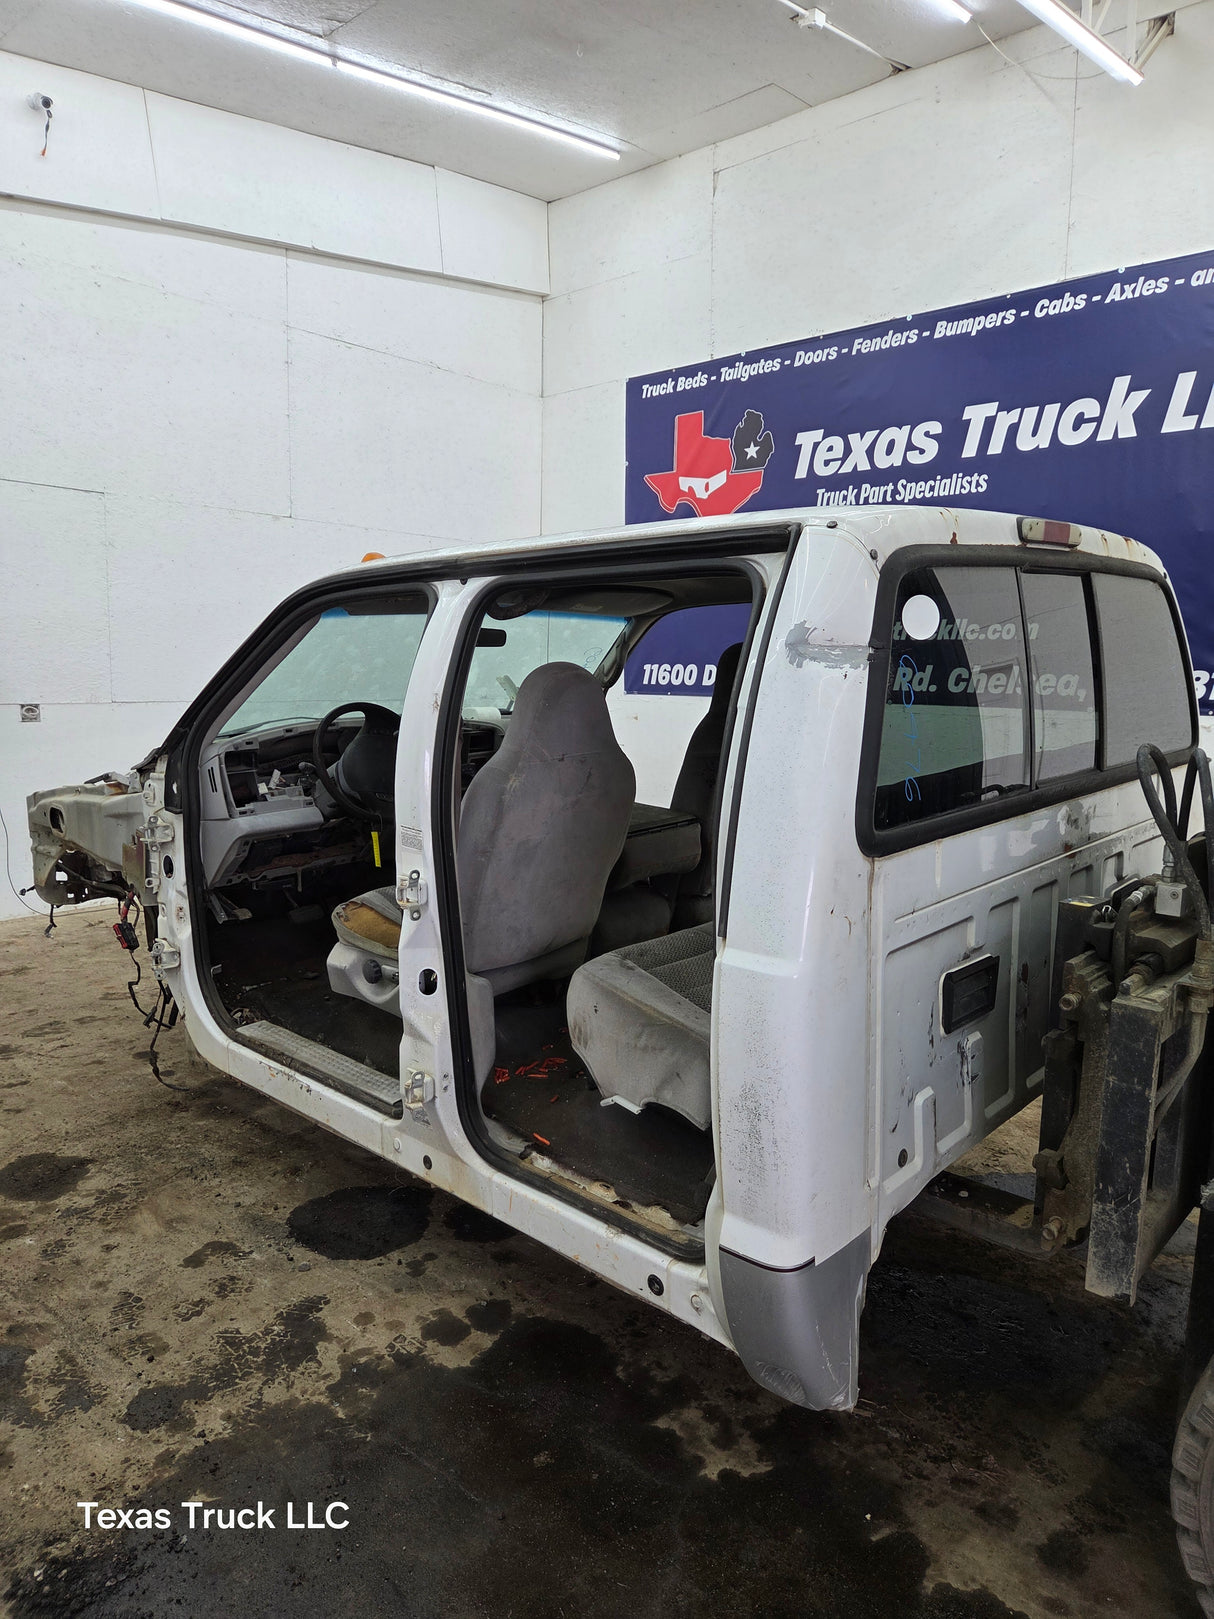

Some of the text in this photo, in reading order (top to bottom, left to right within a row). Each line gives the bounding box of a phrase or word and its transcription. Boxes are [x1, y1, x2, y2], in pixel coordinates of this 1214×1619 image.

[641, 377, 675, 399] Truck
[676, 371, 708, 392] Beds
[720, 357, 781, 382] Tailgates
[794, 344, 838, 367] Doors
[852, 328, 919, 355] Fenders
[934, 308, 1016, 338] Bumpers
[1034, 292, 1087, 318] Cabs
[1105, 275, 1170, 304] Axles
[794, 420, 943, 480] Texas
[961, 374, 1152, 459] Truck
[816, 472, 988, 507] Truck Part Specialists
[643, 663, 698, 686] 11600
[893, 664, 938, 692] Rd.
